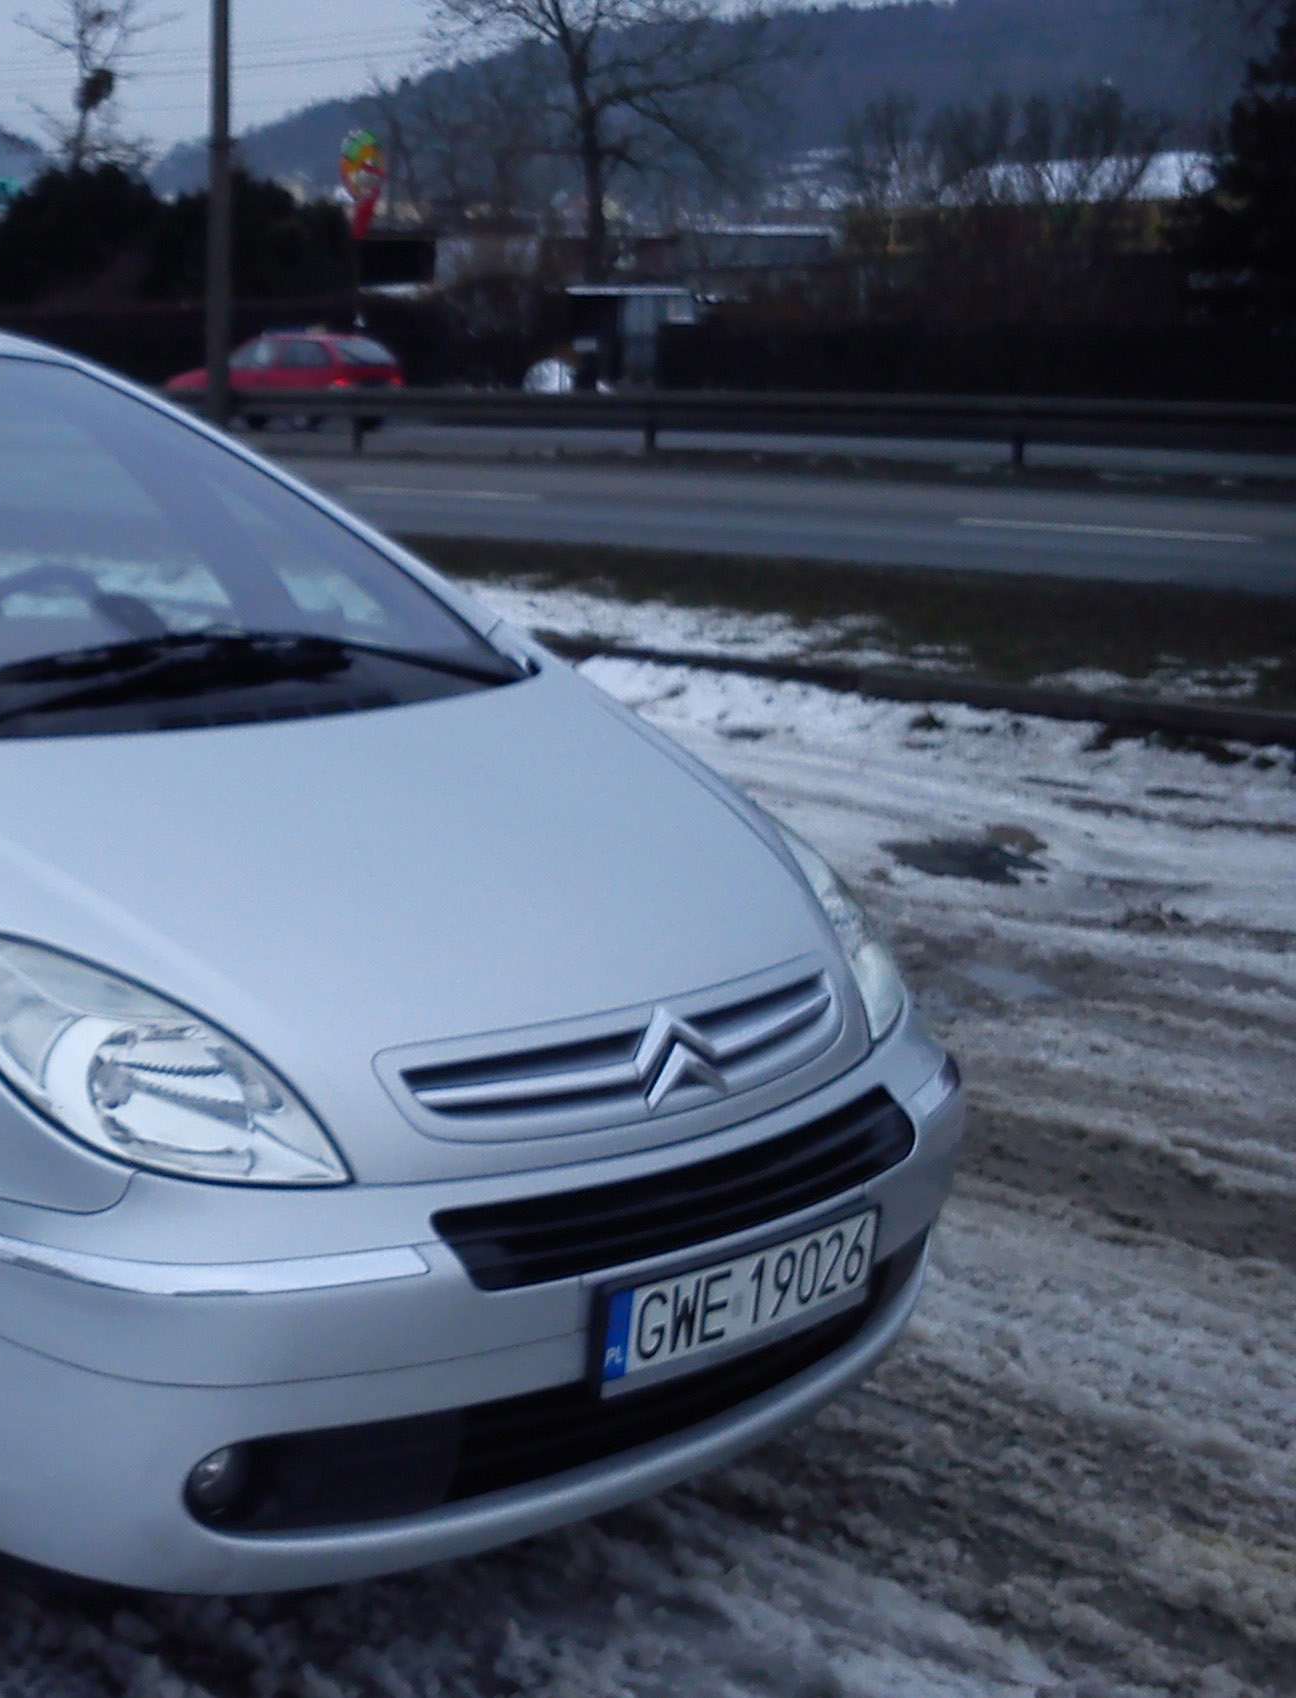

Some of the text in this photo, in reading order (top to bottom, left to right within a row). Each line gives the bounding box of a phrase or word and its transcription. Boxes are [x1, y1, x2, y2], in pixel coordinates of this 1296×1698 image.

[636, 1215, 867, 1360] GWE 19026
[604, 1345, 623, 1368] PL
